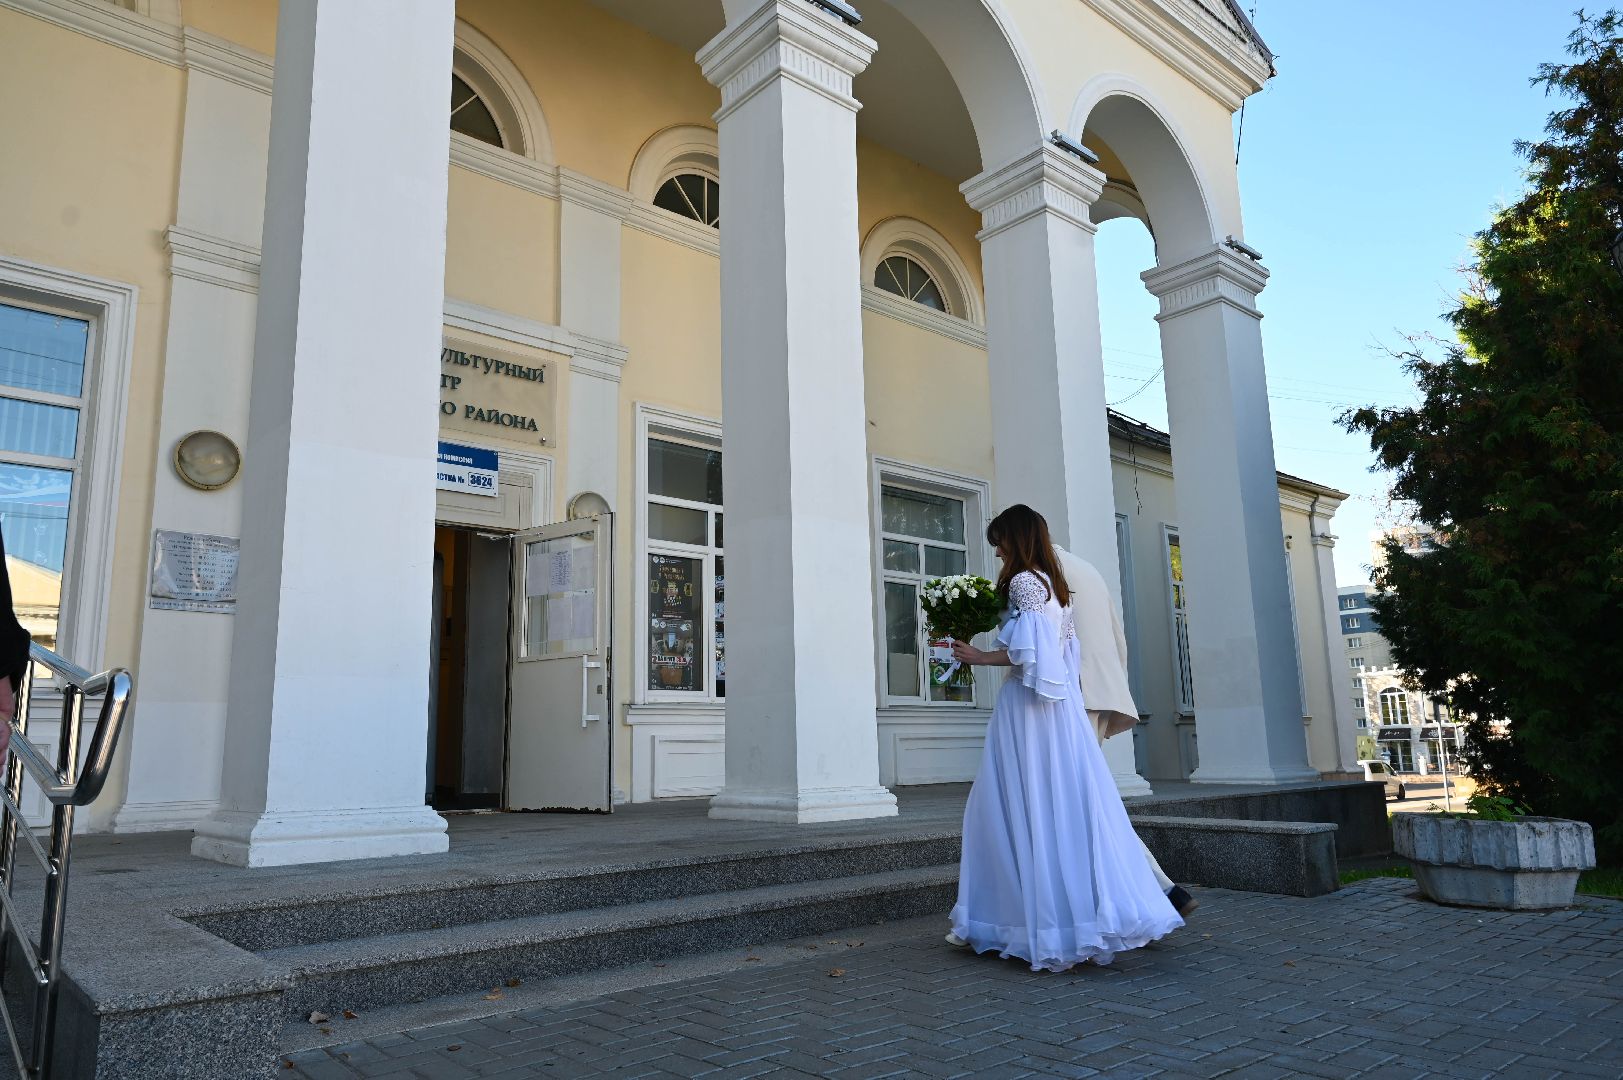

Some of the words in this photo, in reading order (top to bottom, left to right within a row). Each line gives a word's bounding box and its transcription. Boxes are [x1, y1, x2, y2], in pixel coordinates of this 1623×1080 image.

[441, 347, 545, 383] УЛЬТУРНЫЙ
[440, 373, 462, 390] ТР
[465, 405, 539, 432] РАЙОНА
